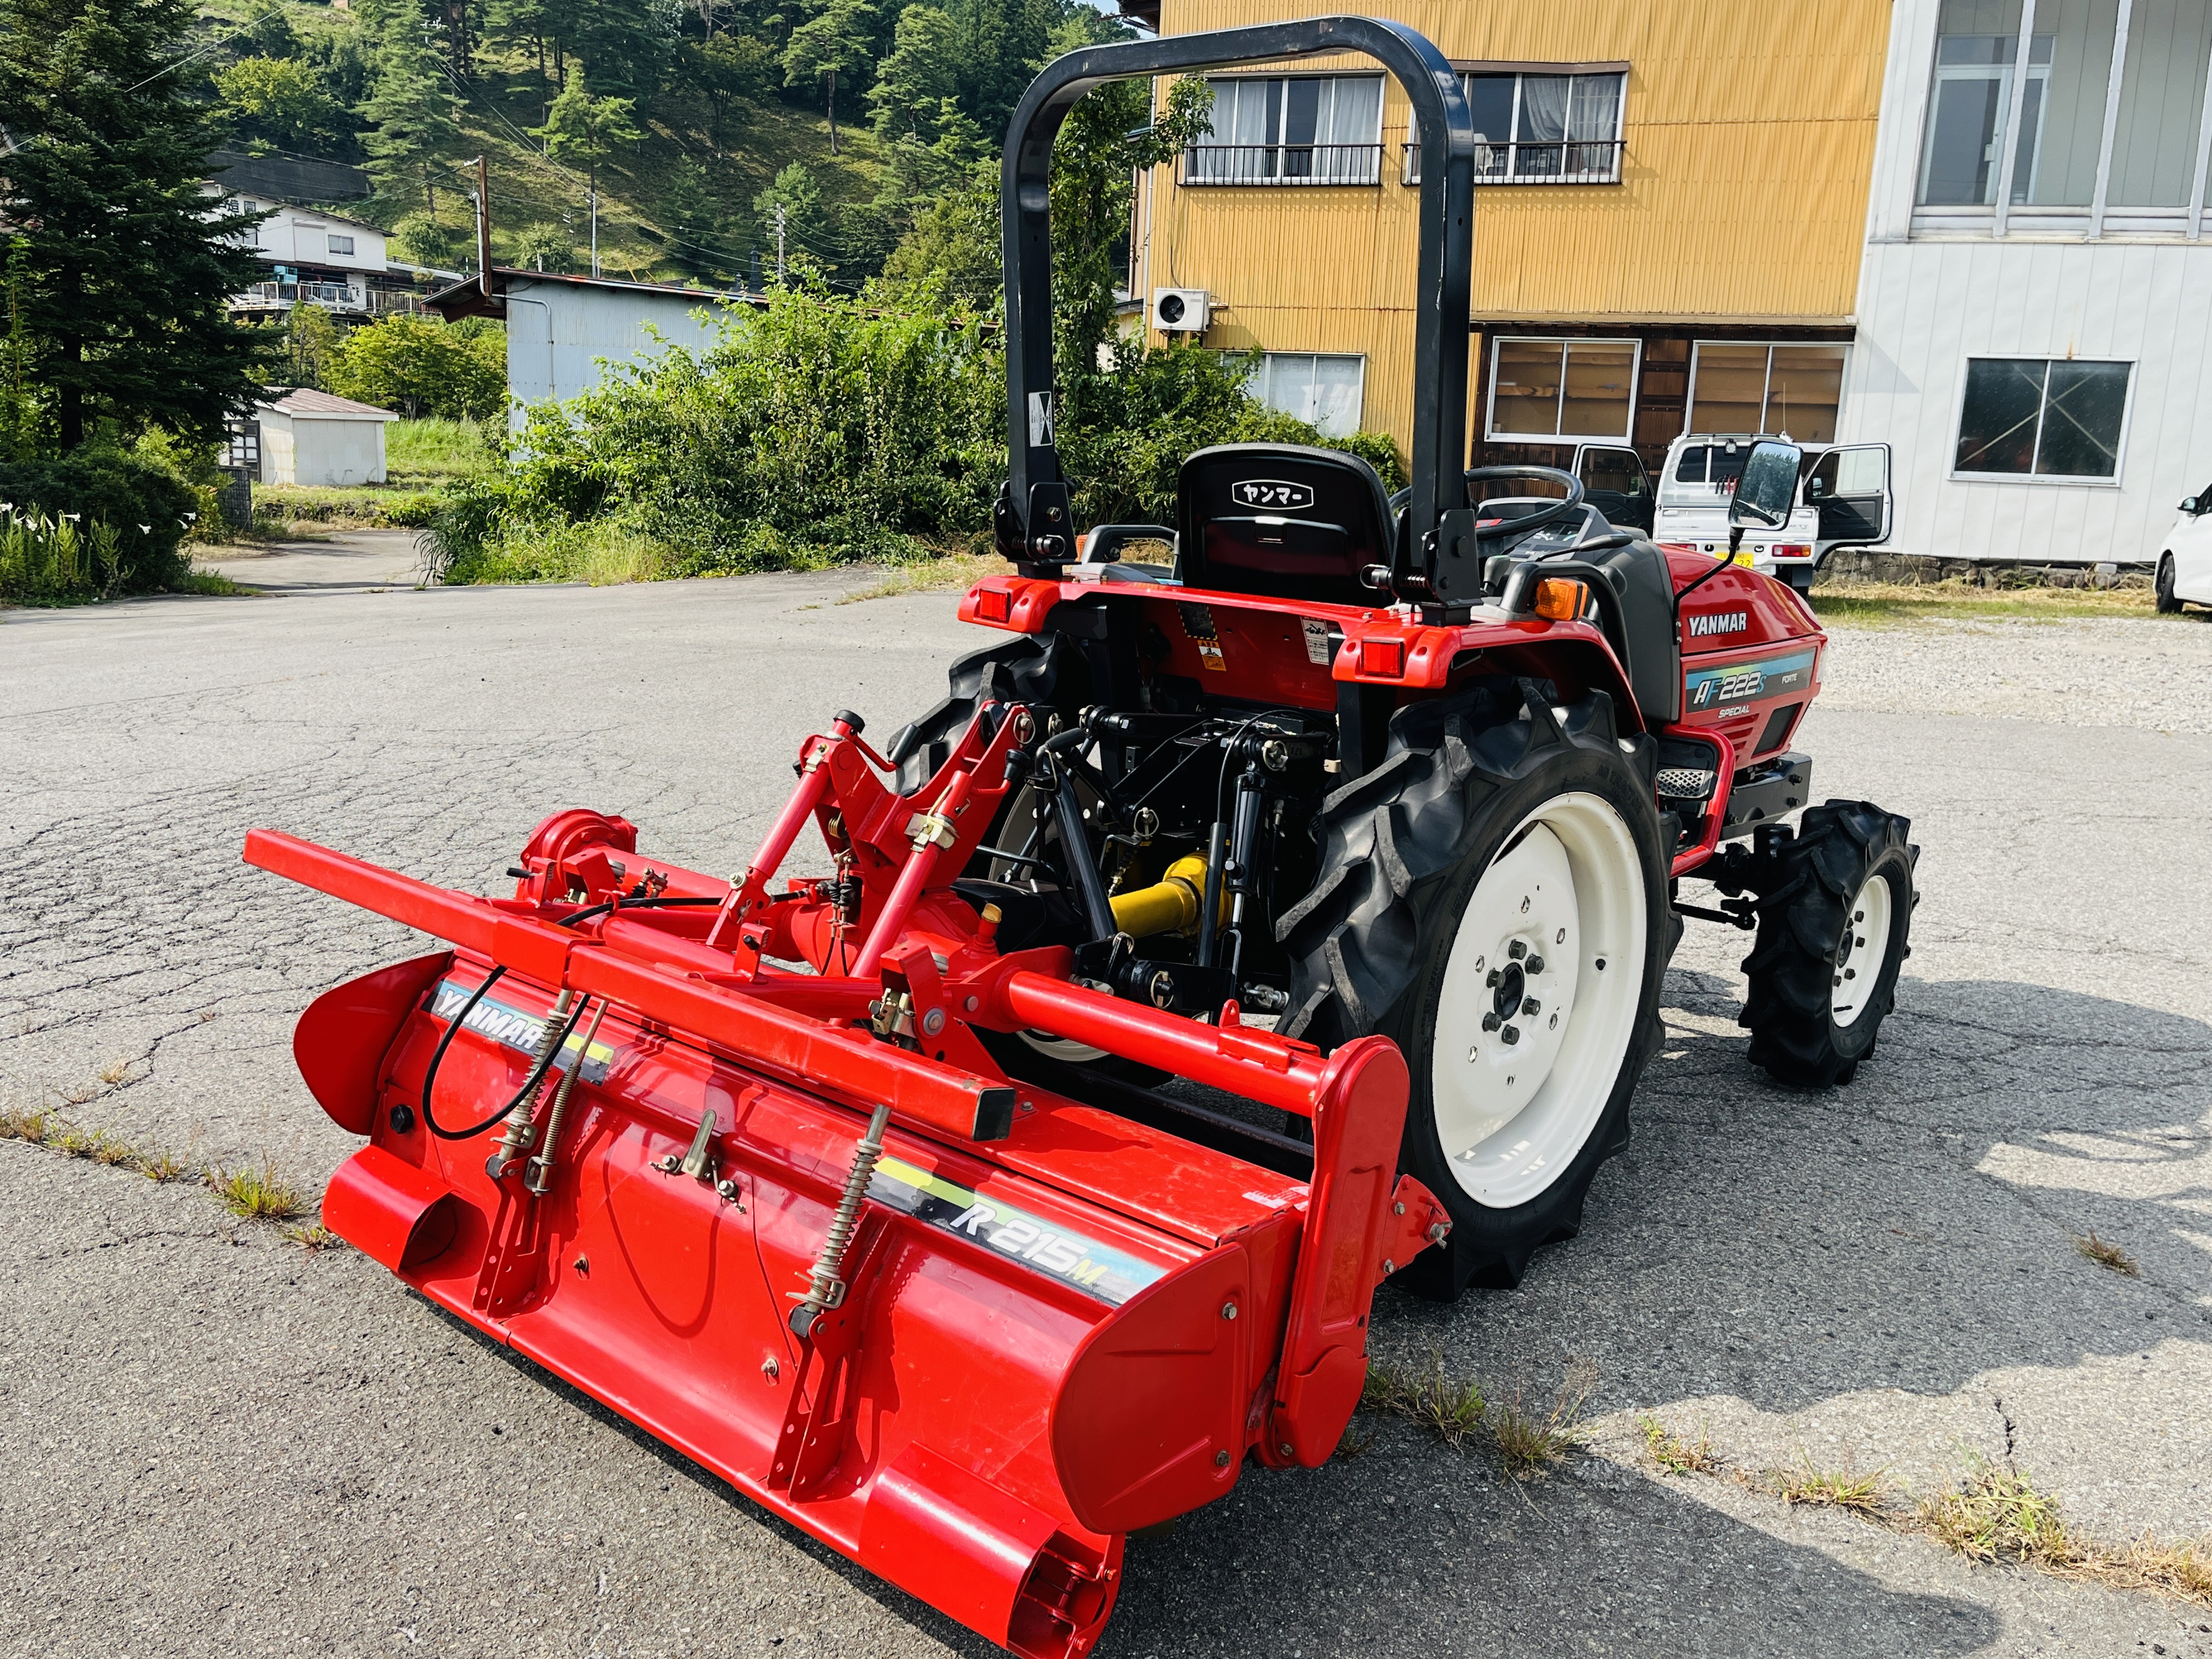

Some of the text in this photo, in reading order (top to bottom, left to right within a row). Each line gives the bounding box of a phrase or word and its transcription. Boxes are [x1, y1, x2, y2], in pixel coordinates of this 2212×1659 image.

[1243, 484, 1302, 504] ヤンマー
[1689, 612, 1747, 636] YANMAR
[1781, 673, 1798, 685] FORTE
[1718, 704, 1750, 719] SPECIAL
[437, 990, 545, 1049] YANMAR
